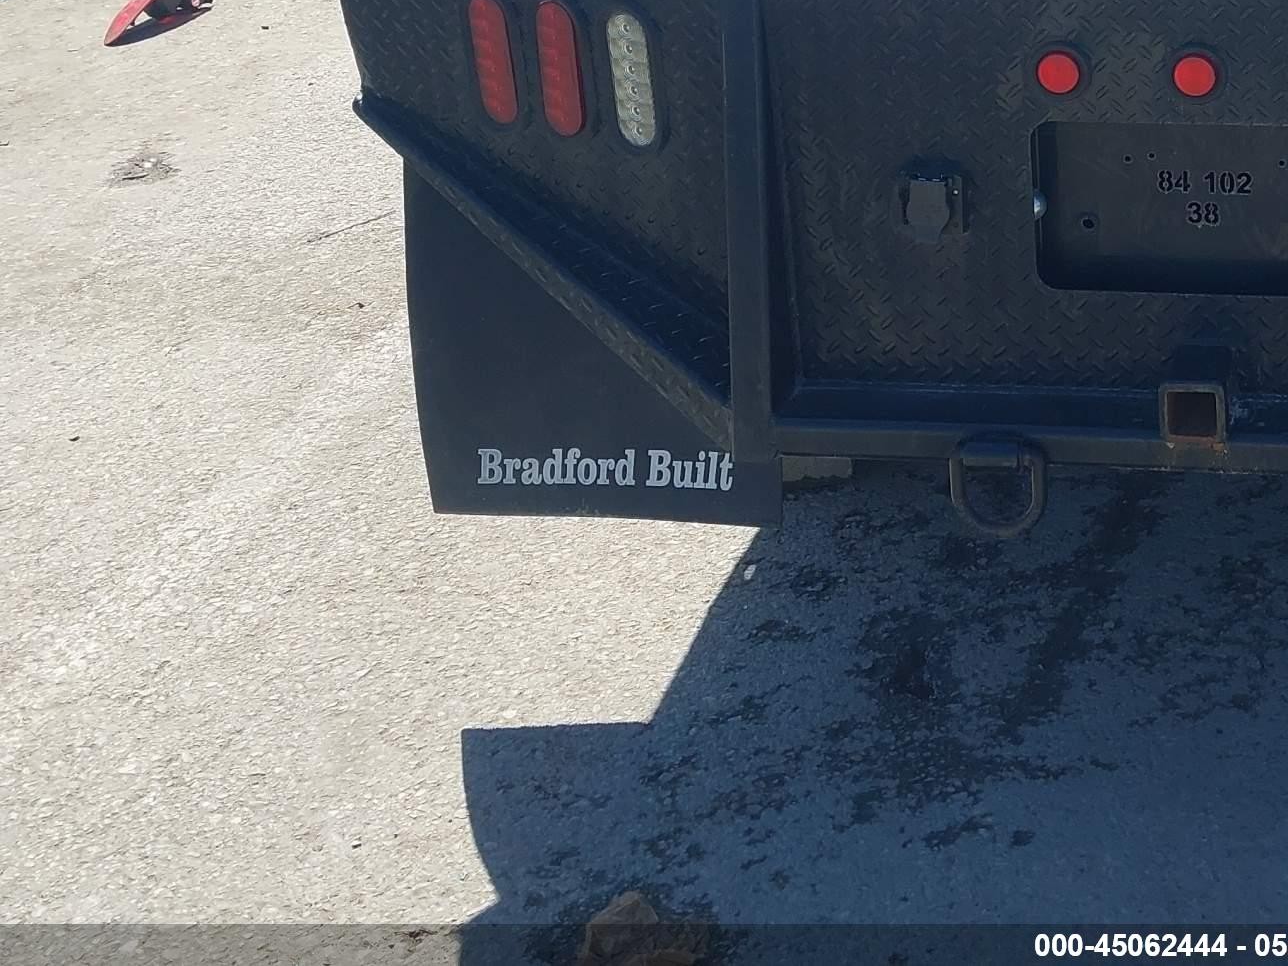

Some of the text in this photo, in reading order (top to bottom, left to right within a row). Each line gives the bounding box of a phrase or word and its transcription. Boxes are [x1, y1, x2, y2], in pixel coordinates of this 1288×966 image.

[1157, 170, 1251, 194] 84 102
[1186, 202, 1219, 225] 38
[477, 448, 733, 491] Bradford Built
